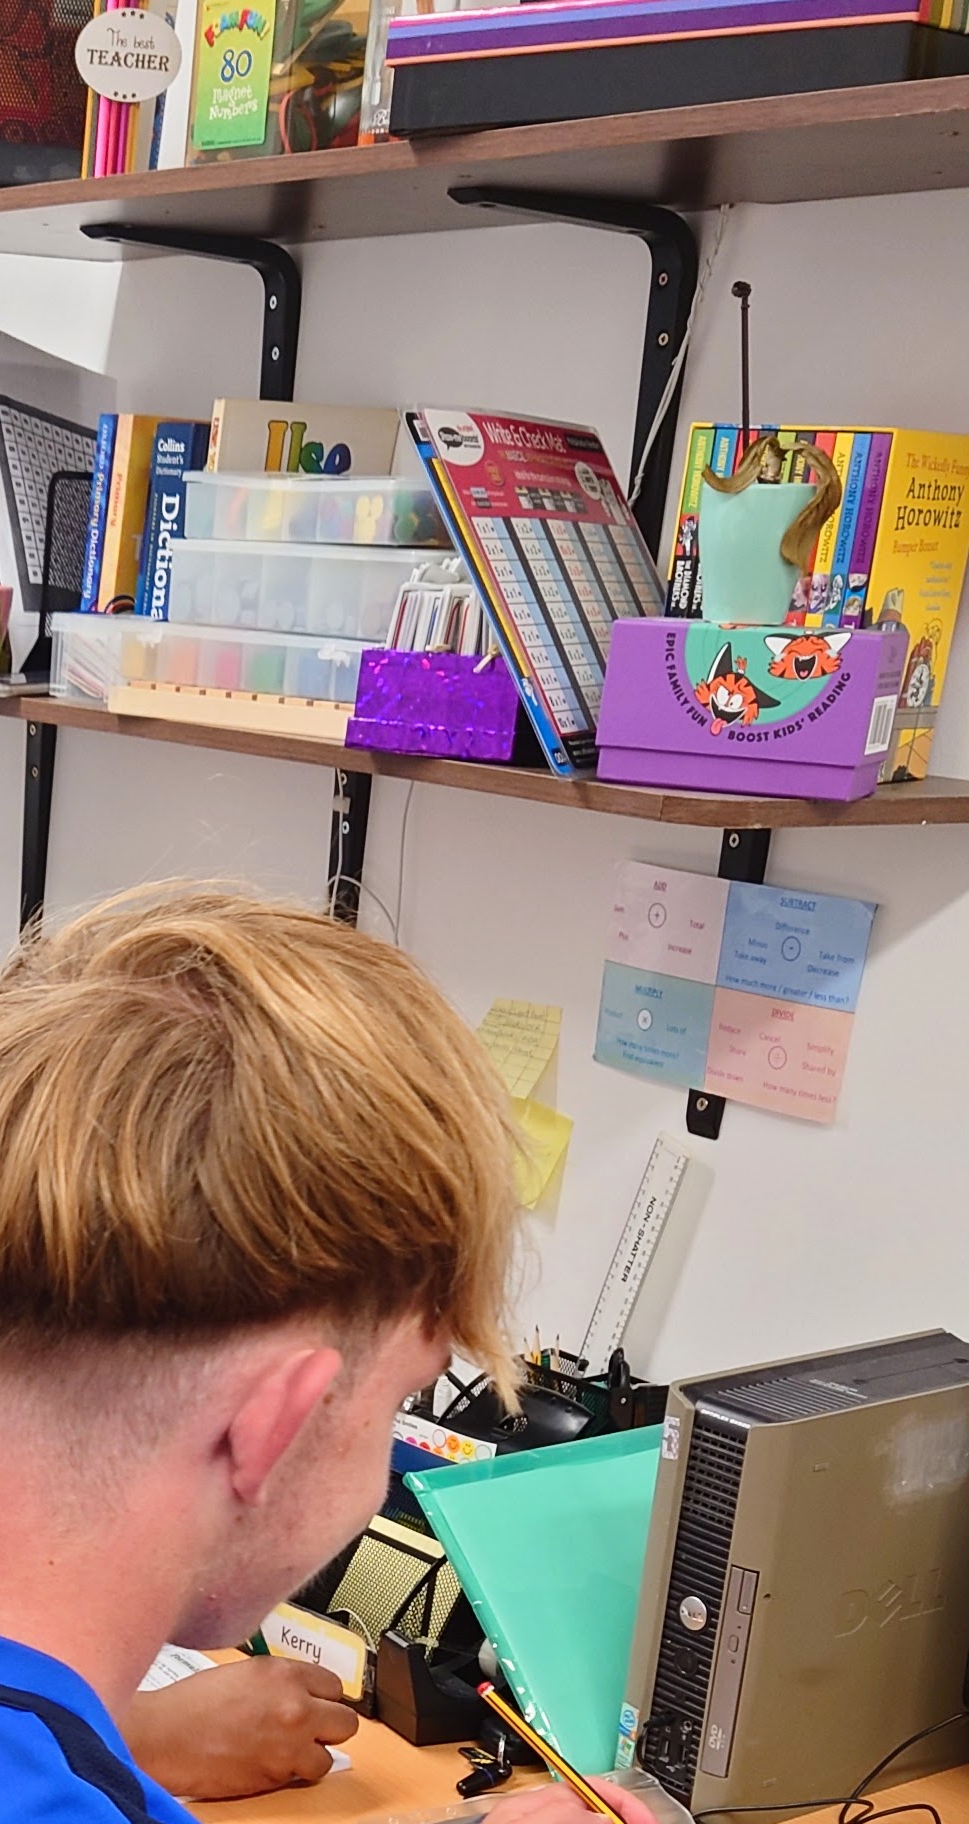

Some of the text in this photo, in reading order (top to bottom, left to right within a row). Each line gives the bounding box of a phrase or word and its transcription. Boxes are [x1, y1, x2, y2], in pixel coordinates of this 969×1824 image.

[107, 28, 155, 49] The best
[87, 49, 169, 72] TEACHER
[220, 49, 252, 83] 80
[213, 85, 252, 107] Magnet
[209, 98, 258, 120] Numbers
[158, 437, 185, 453] Collins
[482, 421, 513, 446] Write
[520, 426, 548, 450] Check
[156, 454, 184, 466] Student's
[717, 437, 730, 473] ANTHONY
[155, 466, 182, 479] Dictionary
[689, 436, 707, 508] ANTHONY HOROWITZ
[90, 472, 106, 528] Primary
[110, 473, 123, 527] Primary
[906, 477, 965, 507] Anthony
[836, 452, 864, 564] ANTHONY HOROWITZ
[856, 452, 884, 564] ANTHONY HOROWITZ
[894, 505, 962, 531] Horowitz
[819, 512, 835, 562] OROWITZ
[84, 525, 101, 599] Dictionary
[151, 492, 180, 620] Dictiona
[672, 560, 685, 601] BROTHERS
[679, 571, 692, 609] DIAMOND
[665, 632, 708, 728] EPIC FAMILY FUN
[727, 671, 851, 743] BOOST KIDS' READING
[653, 880, 667, 892] ADD
[780, 897, 817, 912] SUBTRACT
[689, 920, 705, 930] Total
[775, 922, 810, 935] Difference
[667, 943, 692, 955] Increase
[735, 951, 767, 965] Take away
[819, 951, 855, 964] Take from
[807, 964, 840, 977] Decrease
[635, 985, 663, 999] MULTIPLY
[741, 978, 759, 988] much
[760, 983, 777, 992] more
[782, 985, 807, 996] greater
[814, 991, 827, 1001] less
[772, 1008, 794, 1021] DIVIDE
[666, 1024, 679, 1034] Lots
[759, 1032, 781, 1043] Cancel
[807, 1042, 835, 1055] Simplify
[802, 1062, 836, 1077] Shared by
[763, 1081, 777, 1091] How
[779, 1086, 797, 1096] many
[798, 1090, 817, 1100] times
[281, 1625, 321, 1665] Kerry
[709, 1724, 718, 1748] DVD
